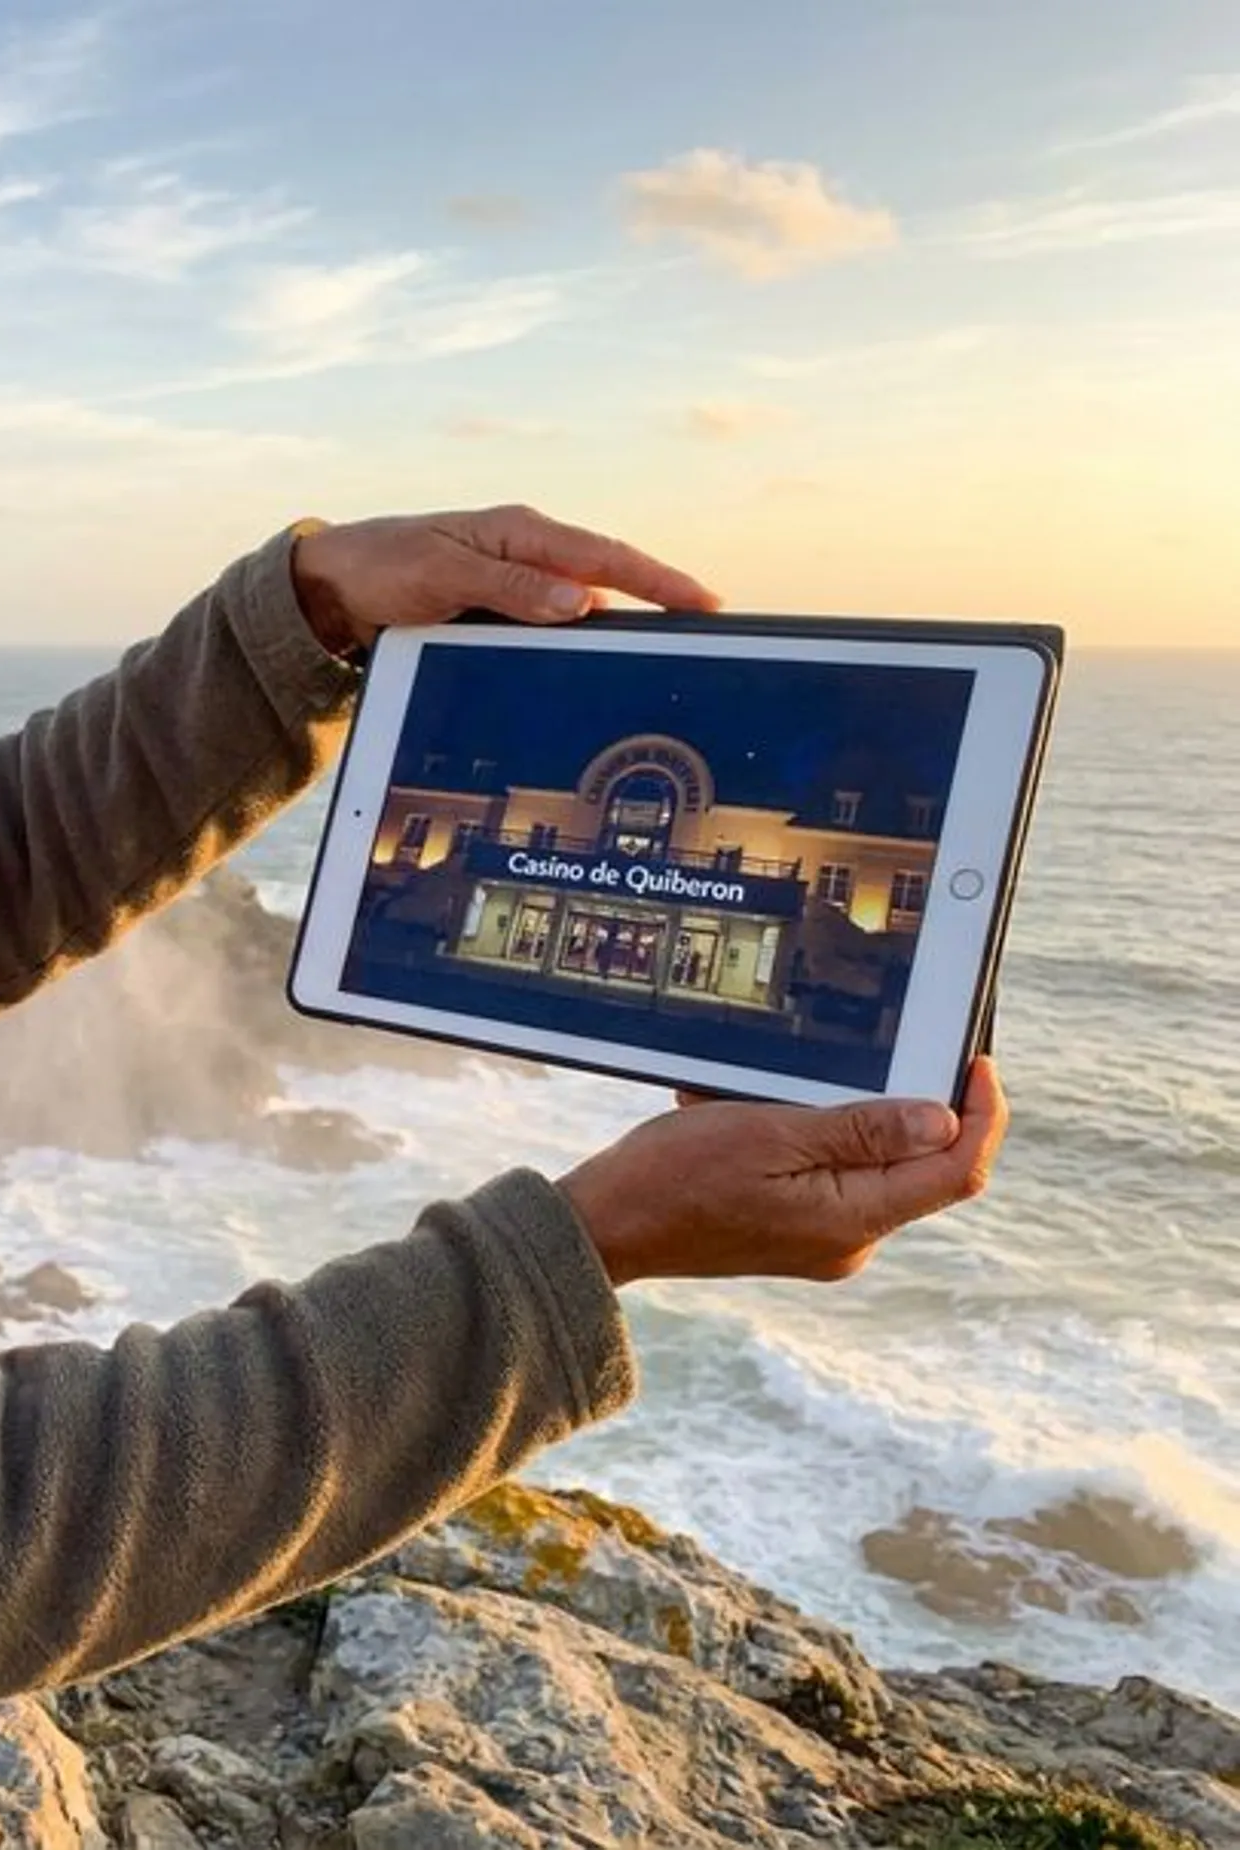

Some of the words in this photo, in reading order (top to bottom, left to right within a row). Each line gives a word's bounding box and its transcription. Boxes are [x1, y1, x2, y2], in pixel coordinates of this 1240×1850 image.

[508, 852, 584, 880] Casino
[589, 861, 620, 885] de
[626, 866, 745, 902] Quiberon
